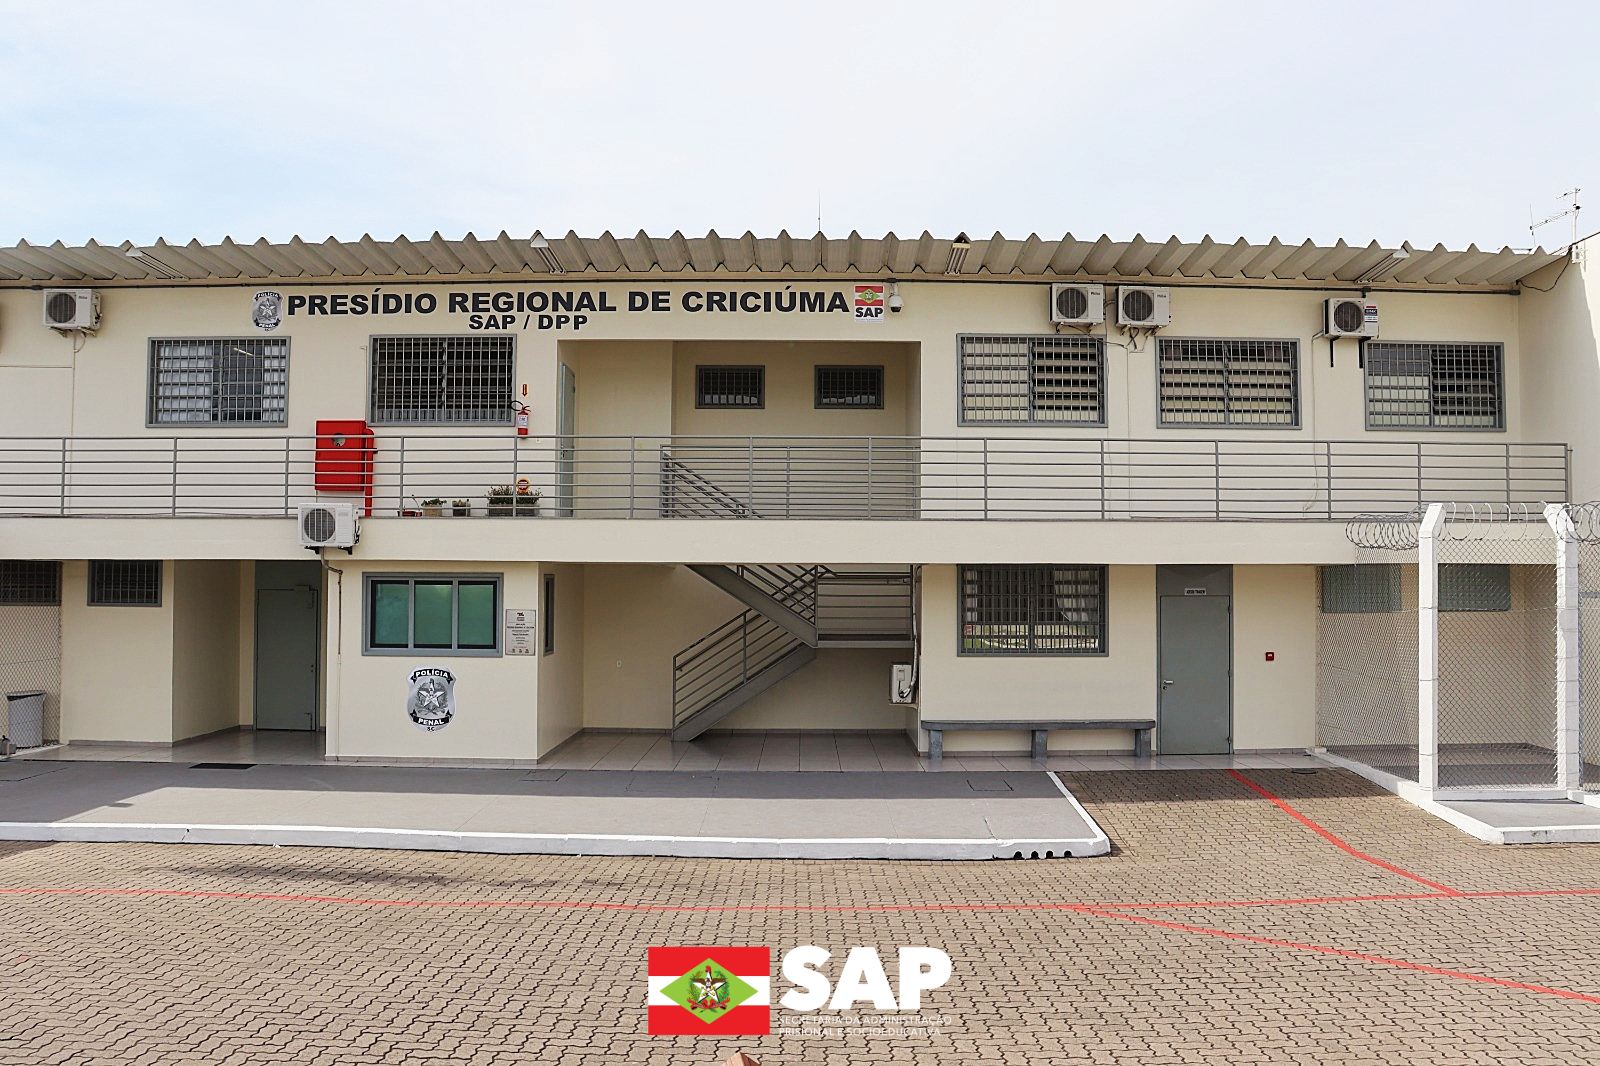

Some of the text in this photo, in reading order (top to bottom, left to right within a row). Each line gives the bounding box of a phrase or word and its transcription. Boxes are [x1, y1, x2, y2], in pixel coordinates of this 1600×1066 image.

[288, 285, 850, 316] PRESÍDIO REGIONAL DE CRICIÚMA
[855, 307, 884, 318] SAP
[468, 314, 588, 331] SAP / DPP
[418, 718, 445, 726] PENAL
